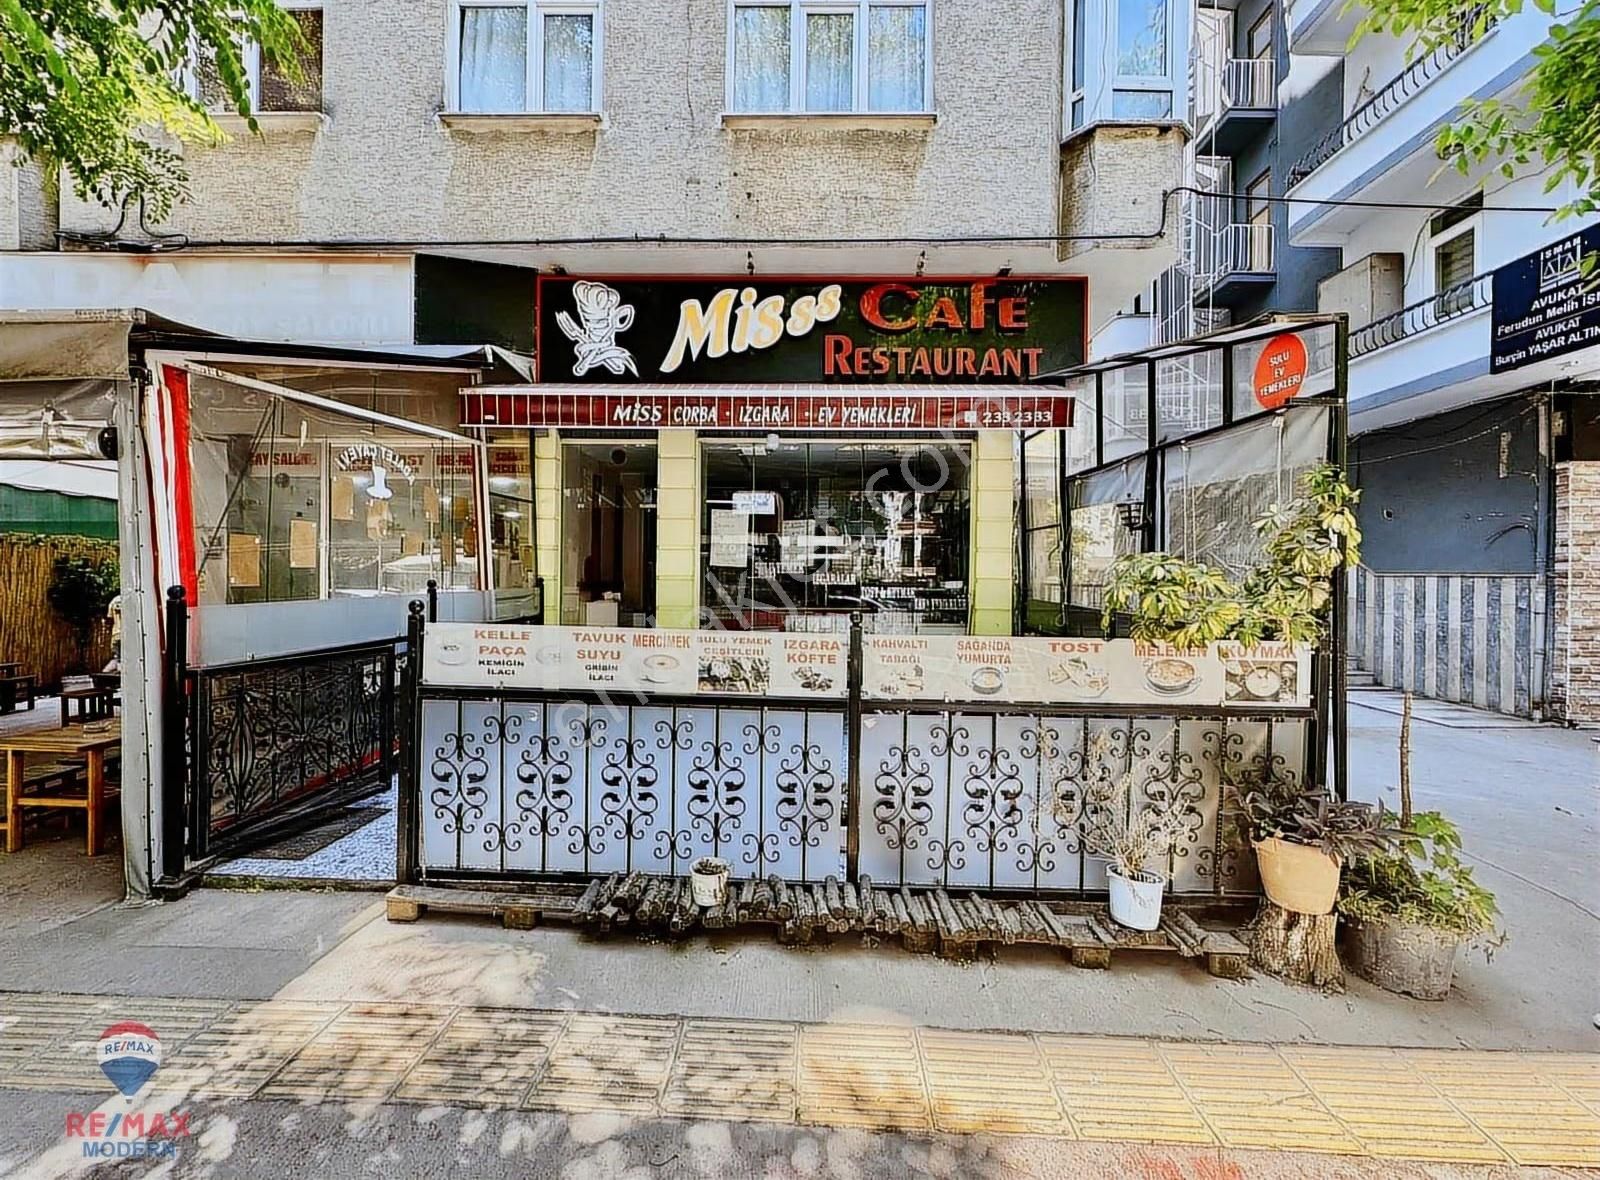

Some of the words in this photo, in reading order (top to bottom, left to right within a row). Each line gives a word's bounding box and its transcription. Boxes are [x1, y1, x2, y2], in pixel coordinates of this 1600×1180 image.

[1531, 282, 1585, 311] AVUKAT
[1497, 314, 1543, 336] Ferudun
[1546, 301, 1578, 320] Melih
[1535, 316, 1582, 341] AVUKAT
[1528, 336, 1566, 356] YAŞAR
[823, 334, 1043, 376] RESTAURANT
[738, 405, 790, 423] IZGARA
[818, 406, 837, 423] EV
[474, 629, 533, 641] KELLE
[572, 632, 627, 644] TAVUK
[730, 636, 773, 646] YEMEK
[783, 639, 841, 651] IZGARA
[872, 639, 929, 649] KAHVALTI
[1048, 642, 1104, 653] TOST
[478, 645, 527, 657] PAÇA
[576, 649, 621, 661] SUYU
[956, 653, 1012, 665] YUMURTA
